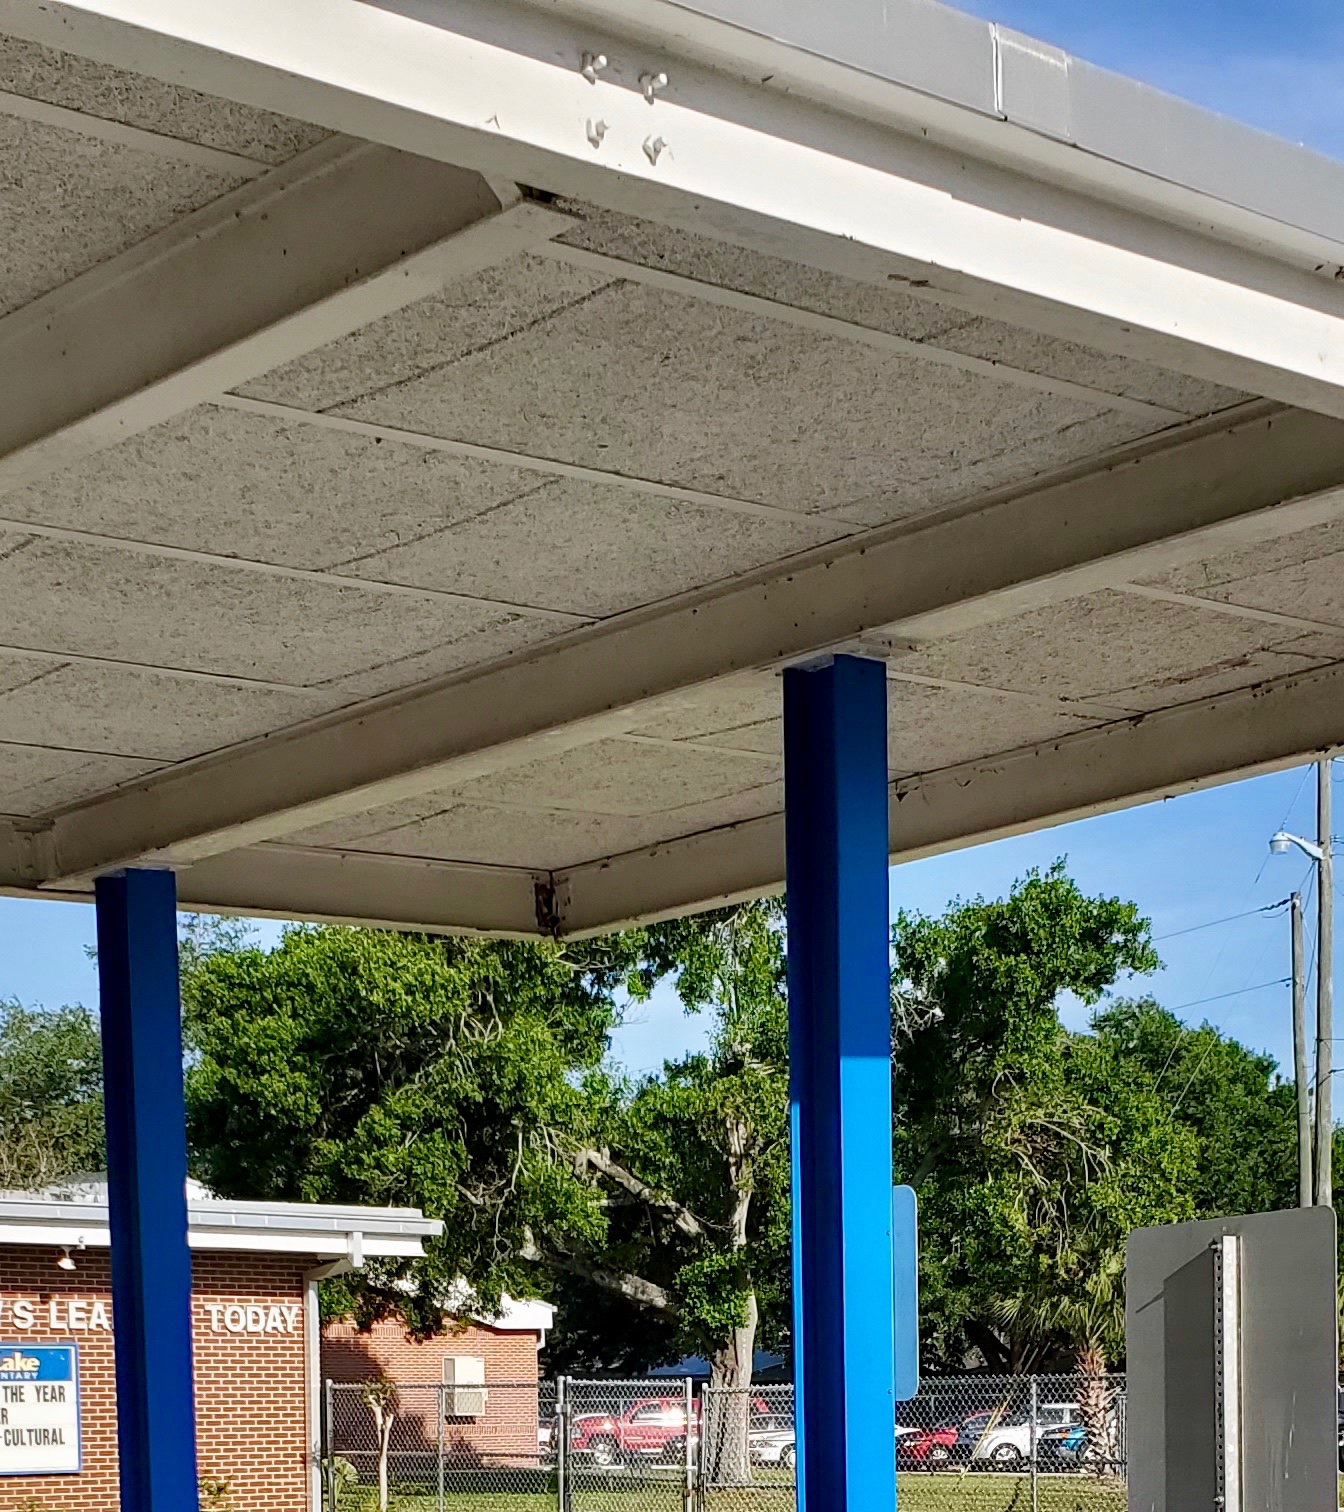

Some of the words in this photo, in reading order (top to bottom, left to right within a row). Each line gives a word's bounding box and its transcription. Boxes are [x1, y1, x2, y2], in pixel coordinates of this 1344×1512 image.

[206, 1304, 299, 1332] TODAY
[2, 1385, 25, 1403] THE
[35, 1385, 65, 1403] YEAR
